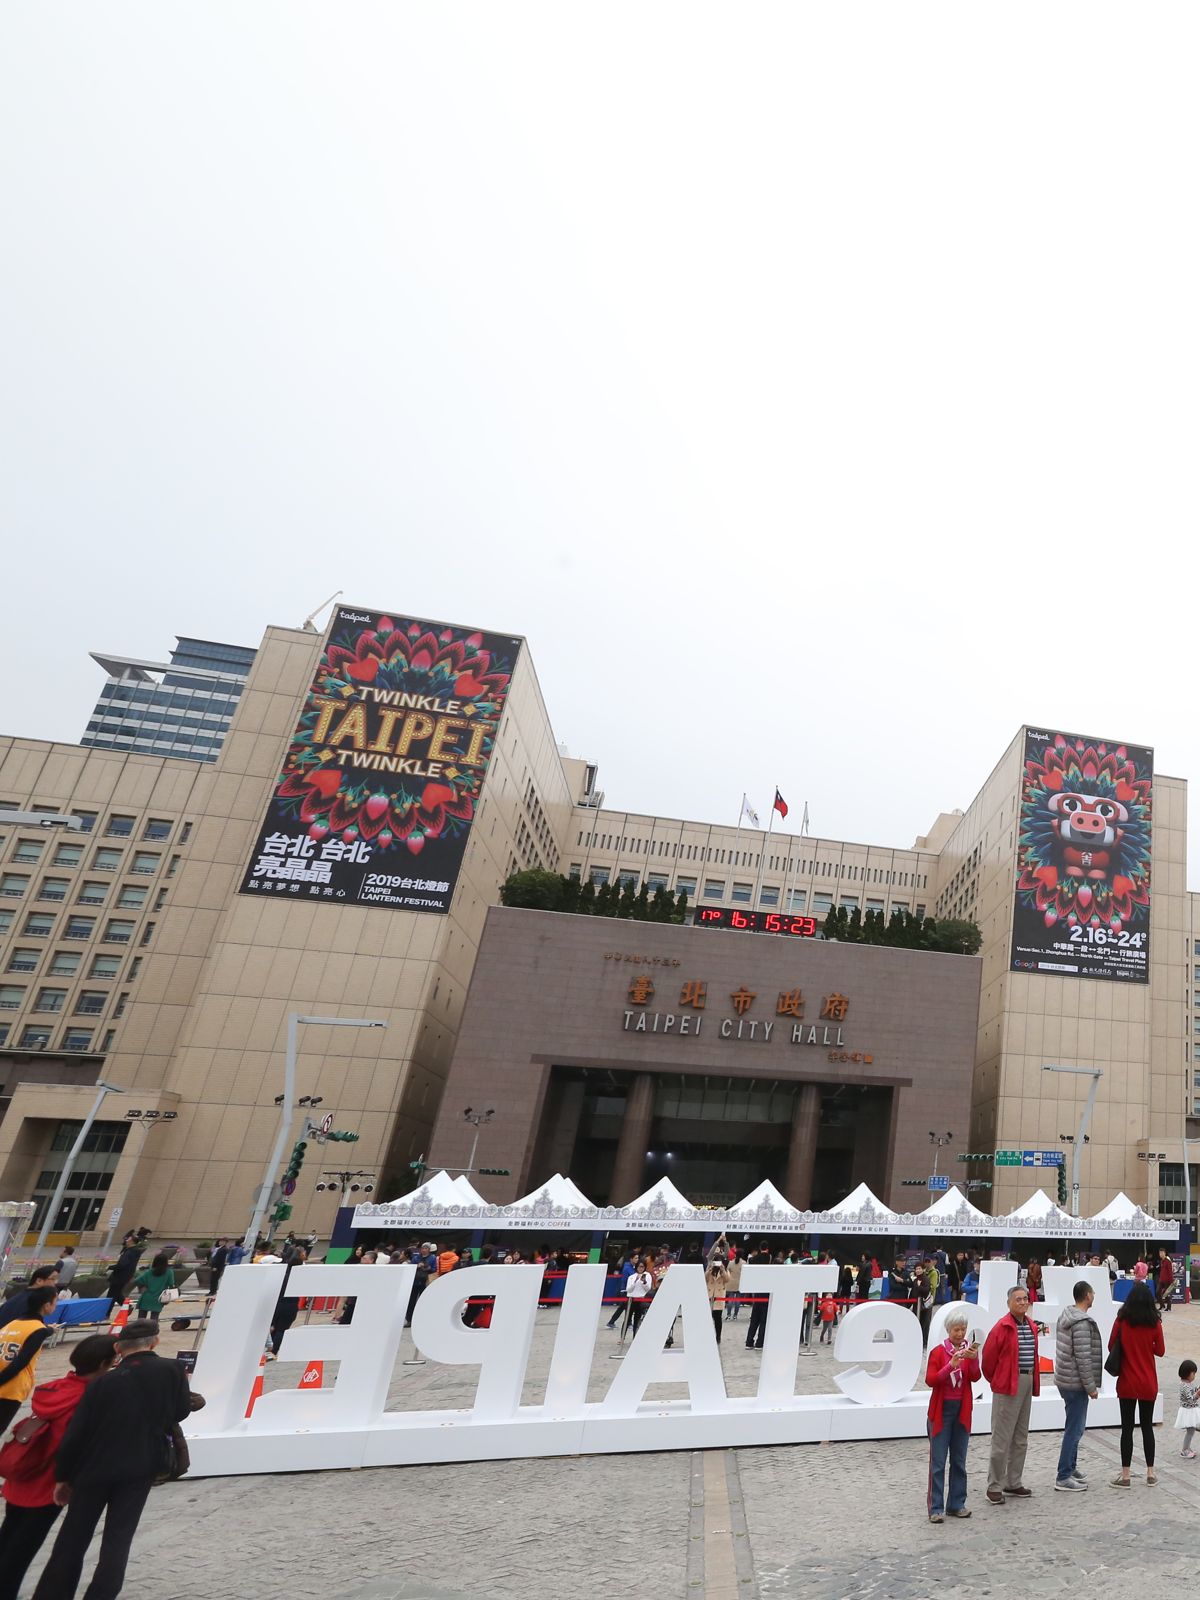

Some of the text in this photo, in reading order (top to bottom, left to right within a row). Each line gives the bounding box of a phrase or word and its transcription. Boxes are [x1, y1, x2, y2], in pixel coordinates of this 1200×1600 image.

[358, 686, 462, 715] TWINKLE
[311, 699, 494, 766] TAIPEI
[336, 749, 444, 779] TWINKLE
[262, 831, 373, 864] 台北 台北
[252, 854, 333, 885] 亮晶晶
[366, 873, 450, 893] 2019台北燈節
[248, 879, 346, 898] 點亮夢想 點亮心
[361, 893, 445, 908] LANTERN FESTIVAL
[363, 885, 391, 895] TAIPEI
[627, 974, 849, 1022] 臺北市政府
[624, 1010, 845, 1047] TAIPEI CITY HALL
